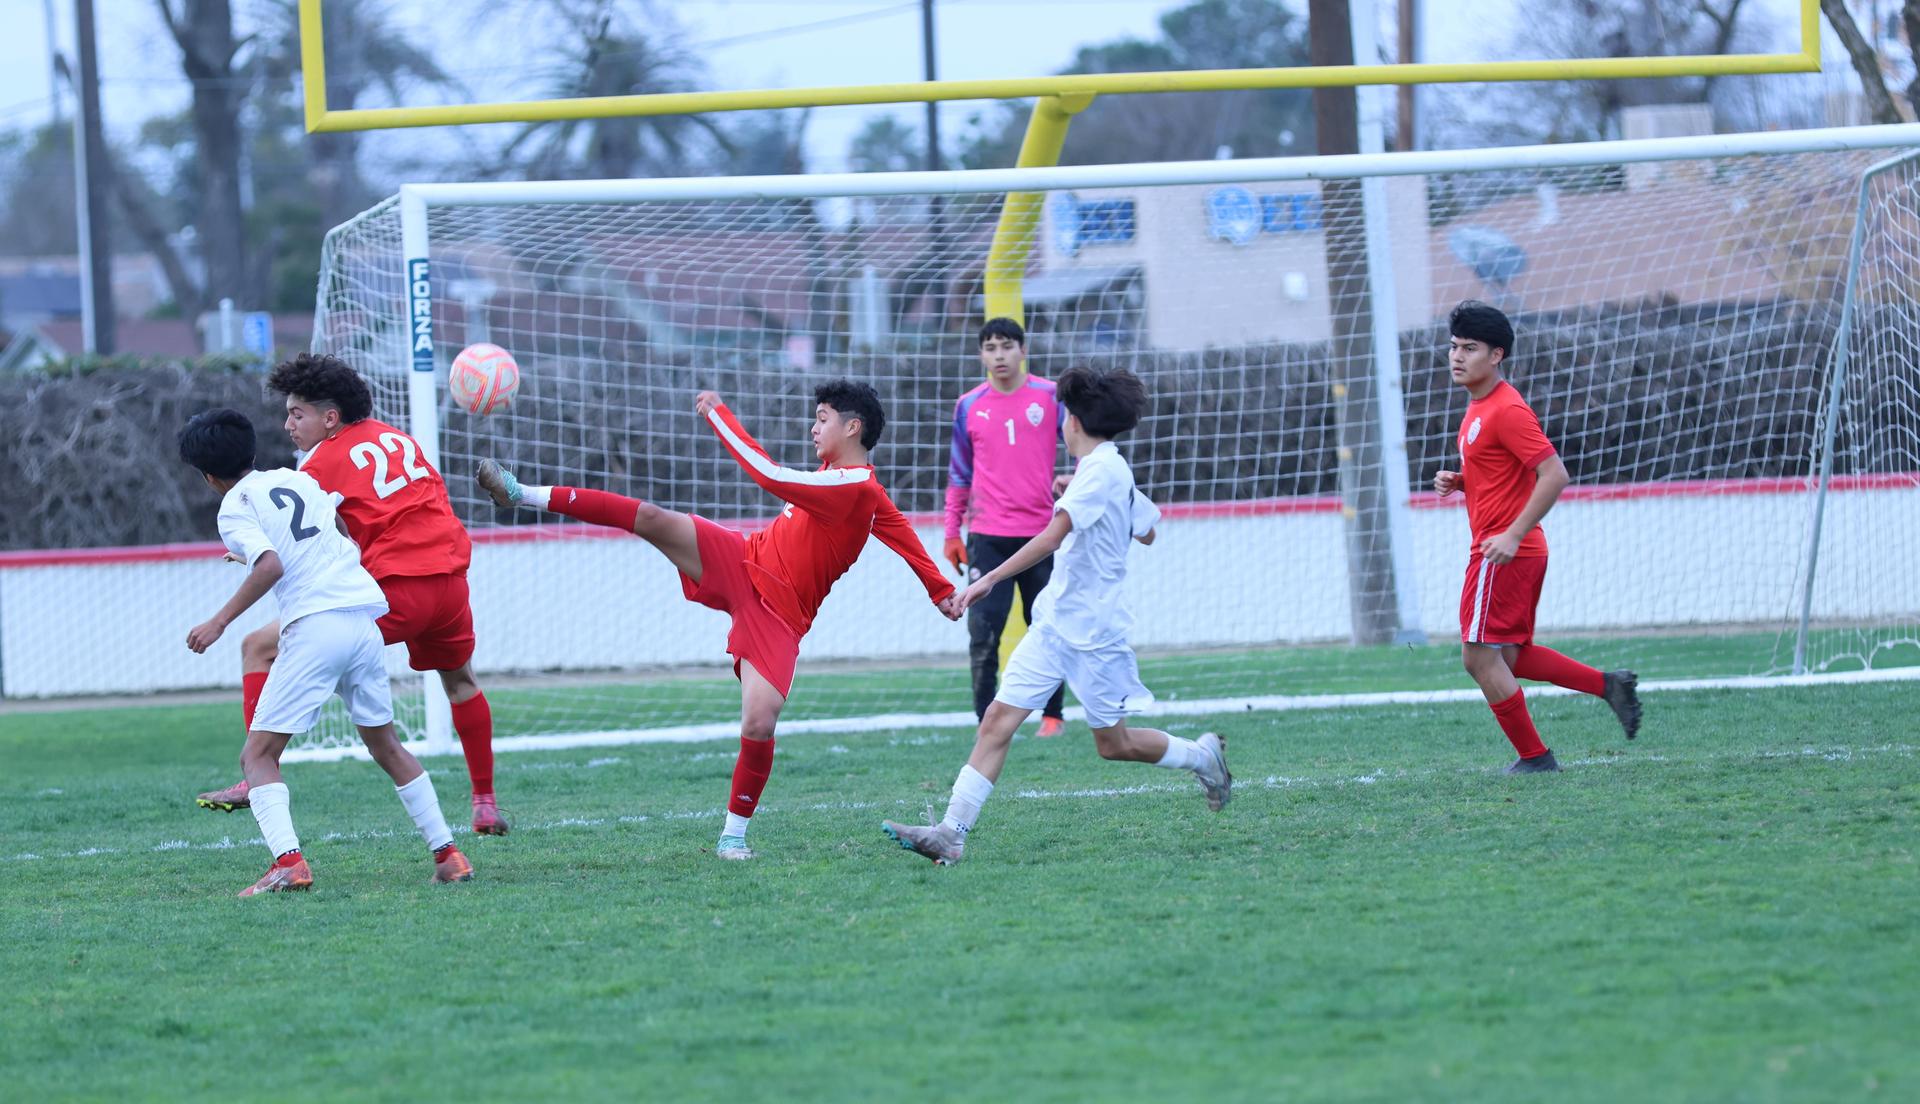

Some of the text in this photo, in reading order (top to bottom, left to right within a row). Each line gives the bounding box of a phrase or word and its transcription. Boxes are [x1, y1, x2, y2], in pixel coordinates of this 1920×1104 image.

[412, 262, 434, 352] FORZA
[1004, 418, 1016, 446] 1
[349, 432, 430, 500] 22
[269, 487, 321, 543] 2
